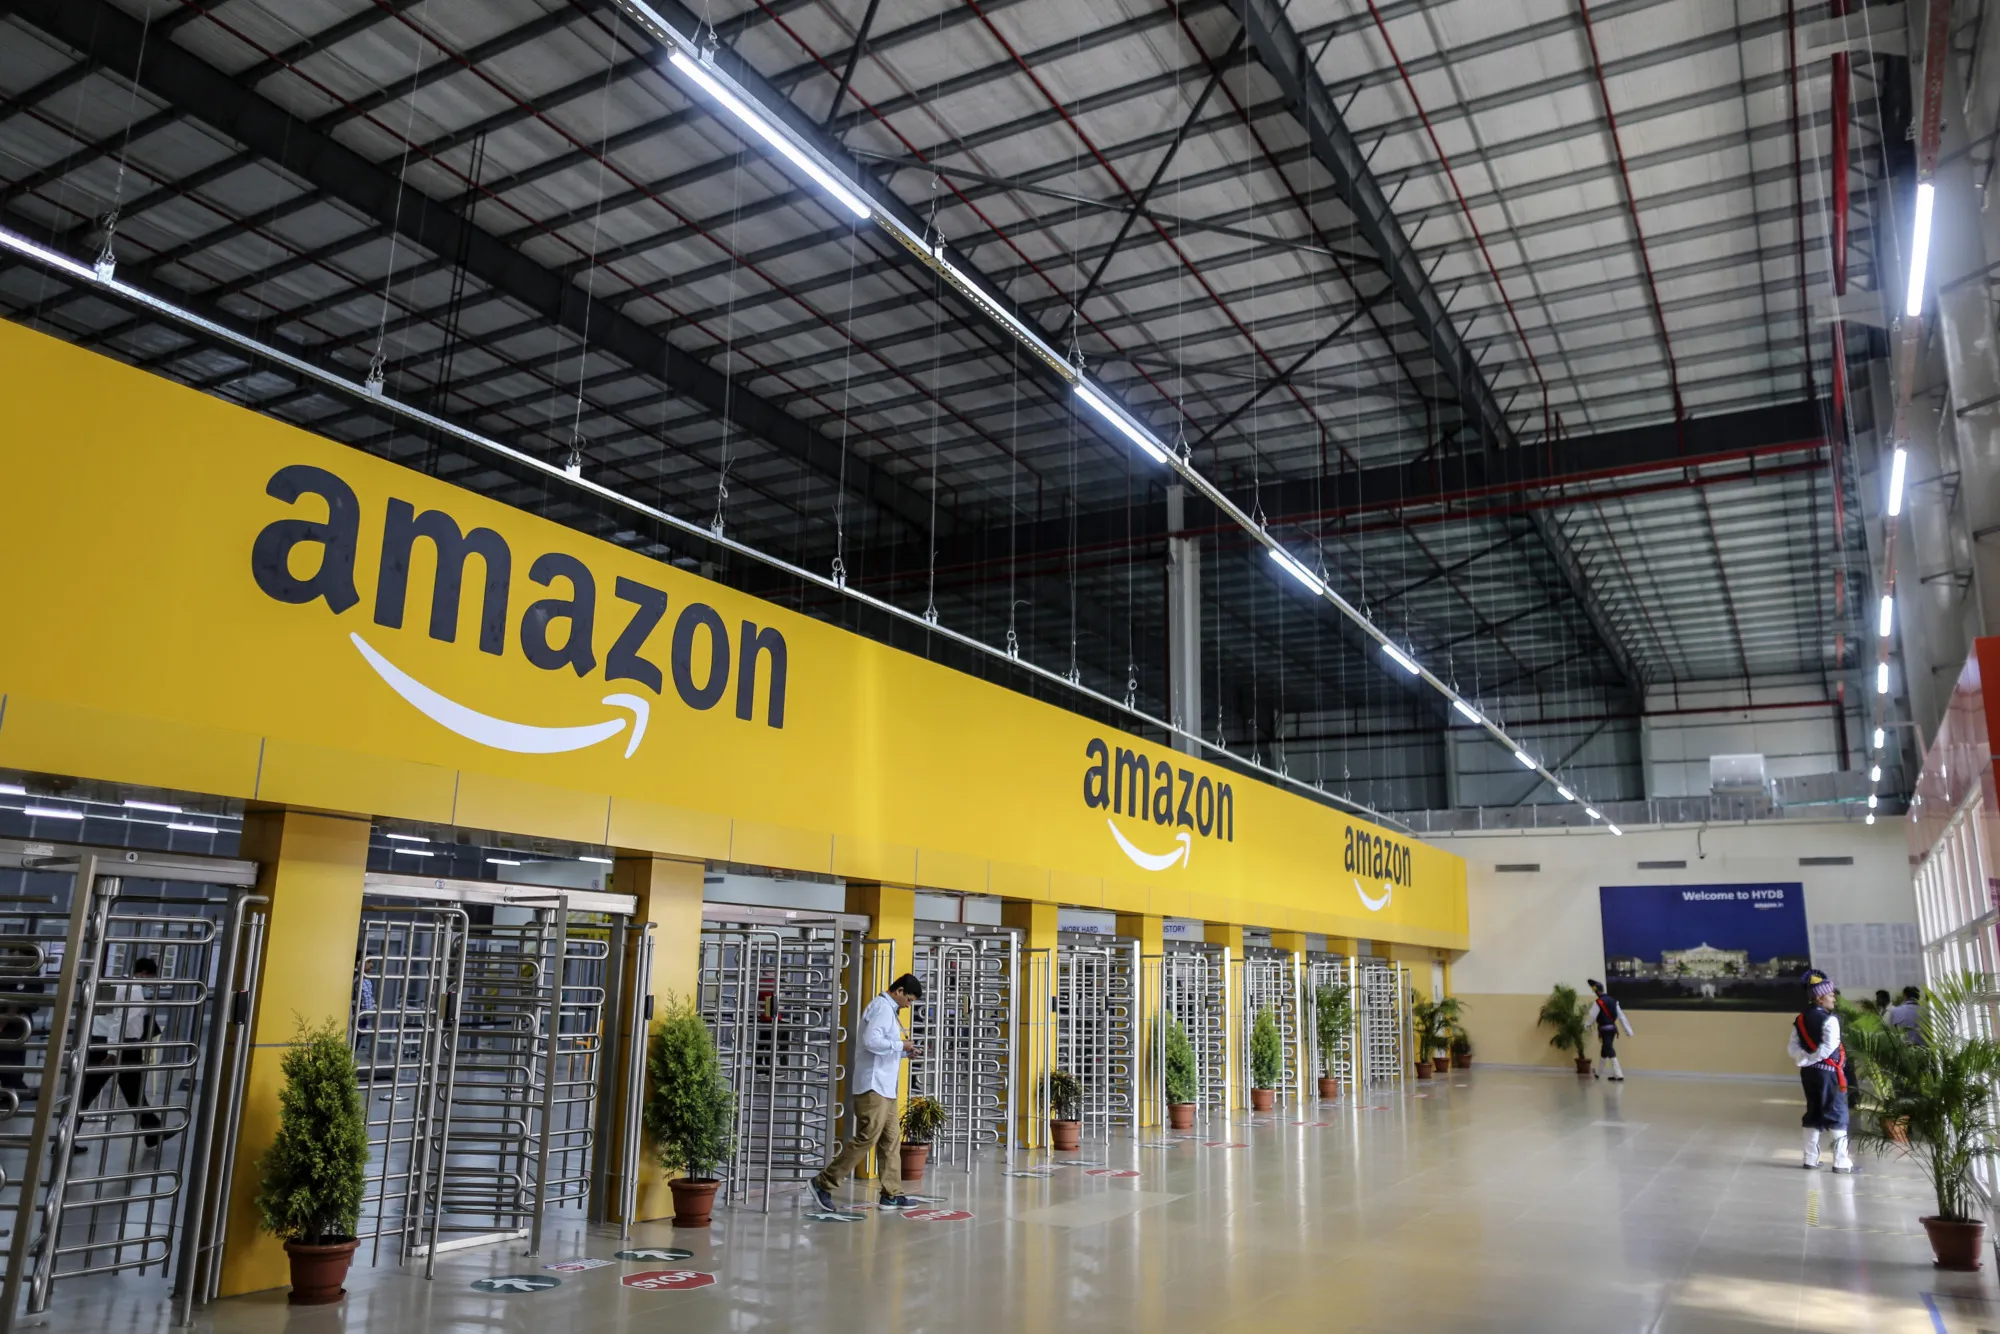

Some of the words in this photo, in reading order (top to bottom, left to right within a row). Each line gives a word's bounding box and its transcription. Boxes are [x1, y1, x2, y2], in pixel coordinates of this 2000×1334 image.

[252, 464, 787, 729] amazon
[1084, 738, 1233, 842] amazon
[1344, 825, 1411, 887] amazon
[1682, 891, 1735, 900] Welcome
[1736, 891, 1749, 900] to
[1751, 890, 1784, 900] HYD8
[631, 1271, 697, 1289] STOP
